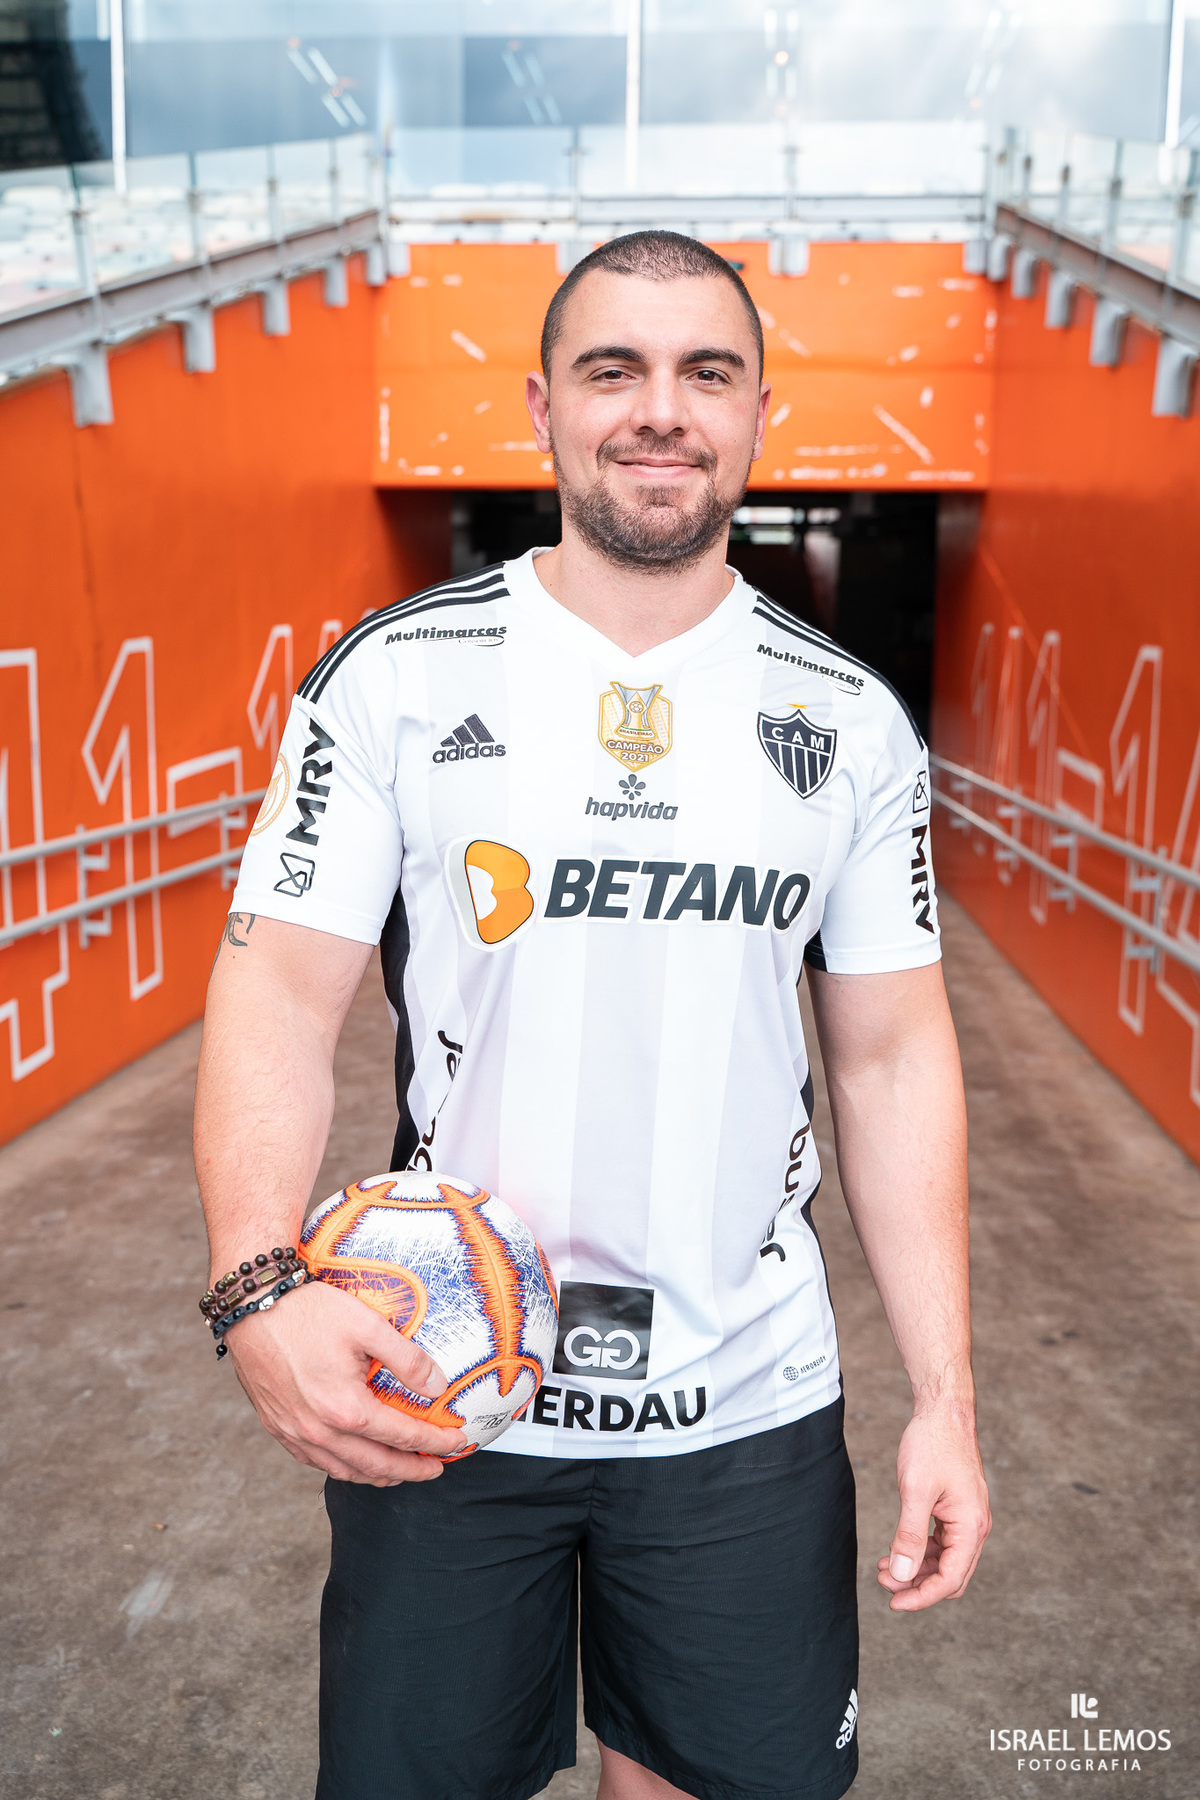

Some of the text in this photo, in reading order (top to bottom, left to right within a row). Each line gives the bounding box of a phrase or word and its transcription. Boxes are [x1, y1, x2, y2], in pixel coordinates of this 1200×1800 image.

[385, 626, 507, 646] Multimarcas
[757, 644, 864, 687] Multimarcas
[607, 739, 663, 755] CAMPEÃO
[771, 726, 825, 751] CAM
[432, 742, 506, 764] adidas
[621, 751, 649, 763] 2021
[286, 717, 335, 847] MRV
[585, 796, 678, 821] hapvida
[911, 824, 935, 935] MRV
[544, 858, 810, 931] BETANO
[516, 1385, 707, 1433] ERDAU
